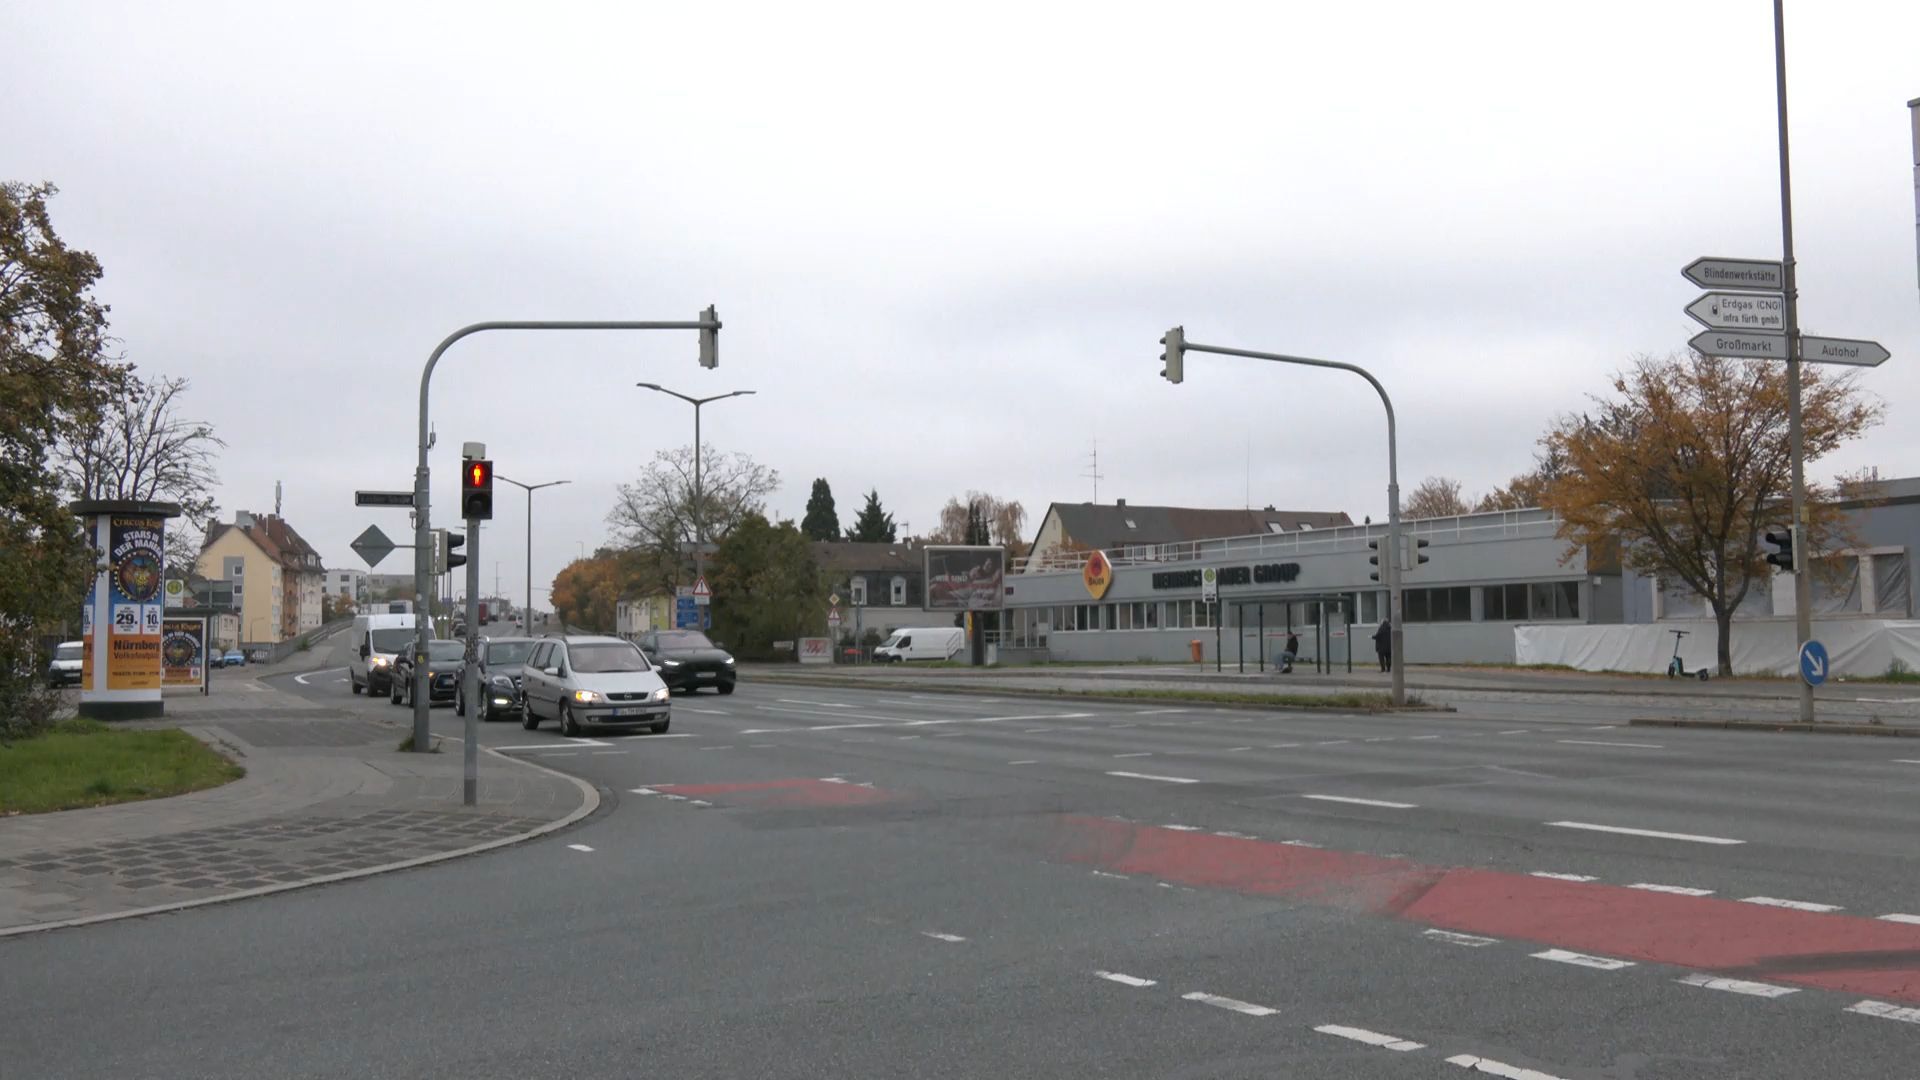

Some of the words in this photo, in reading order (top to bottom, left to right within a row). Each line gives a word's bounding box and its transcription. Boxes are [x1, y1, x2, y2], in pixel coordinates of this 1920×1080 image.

[1704, 268, 1776, 282] Blindenwerkstätte
[1722, 299, 1753, 310] Erdgas
[1757, 300, 1781, 311] (CNG)
[1723, 313, 1739, 323] infra
[1741, 314, 1759, 324] fürth
[1761, 315, 1779, 325] gmbh
[1716, 338, 1772, 352] Großmarkt
[1822, 347, 1859, 358] Autohof
[123, 531, 152, 541] STARS
[113, 541, 134, 557] DER
[116, 613, 138, 625] 29.
[146, 613, 159, 625] 10.
